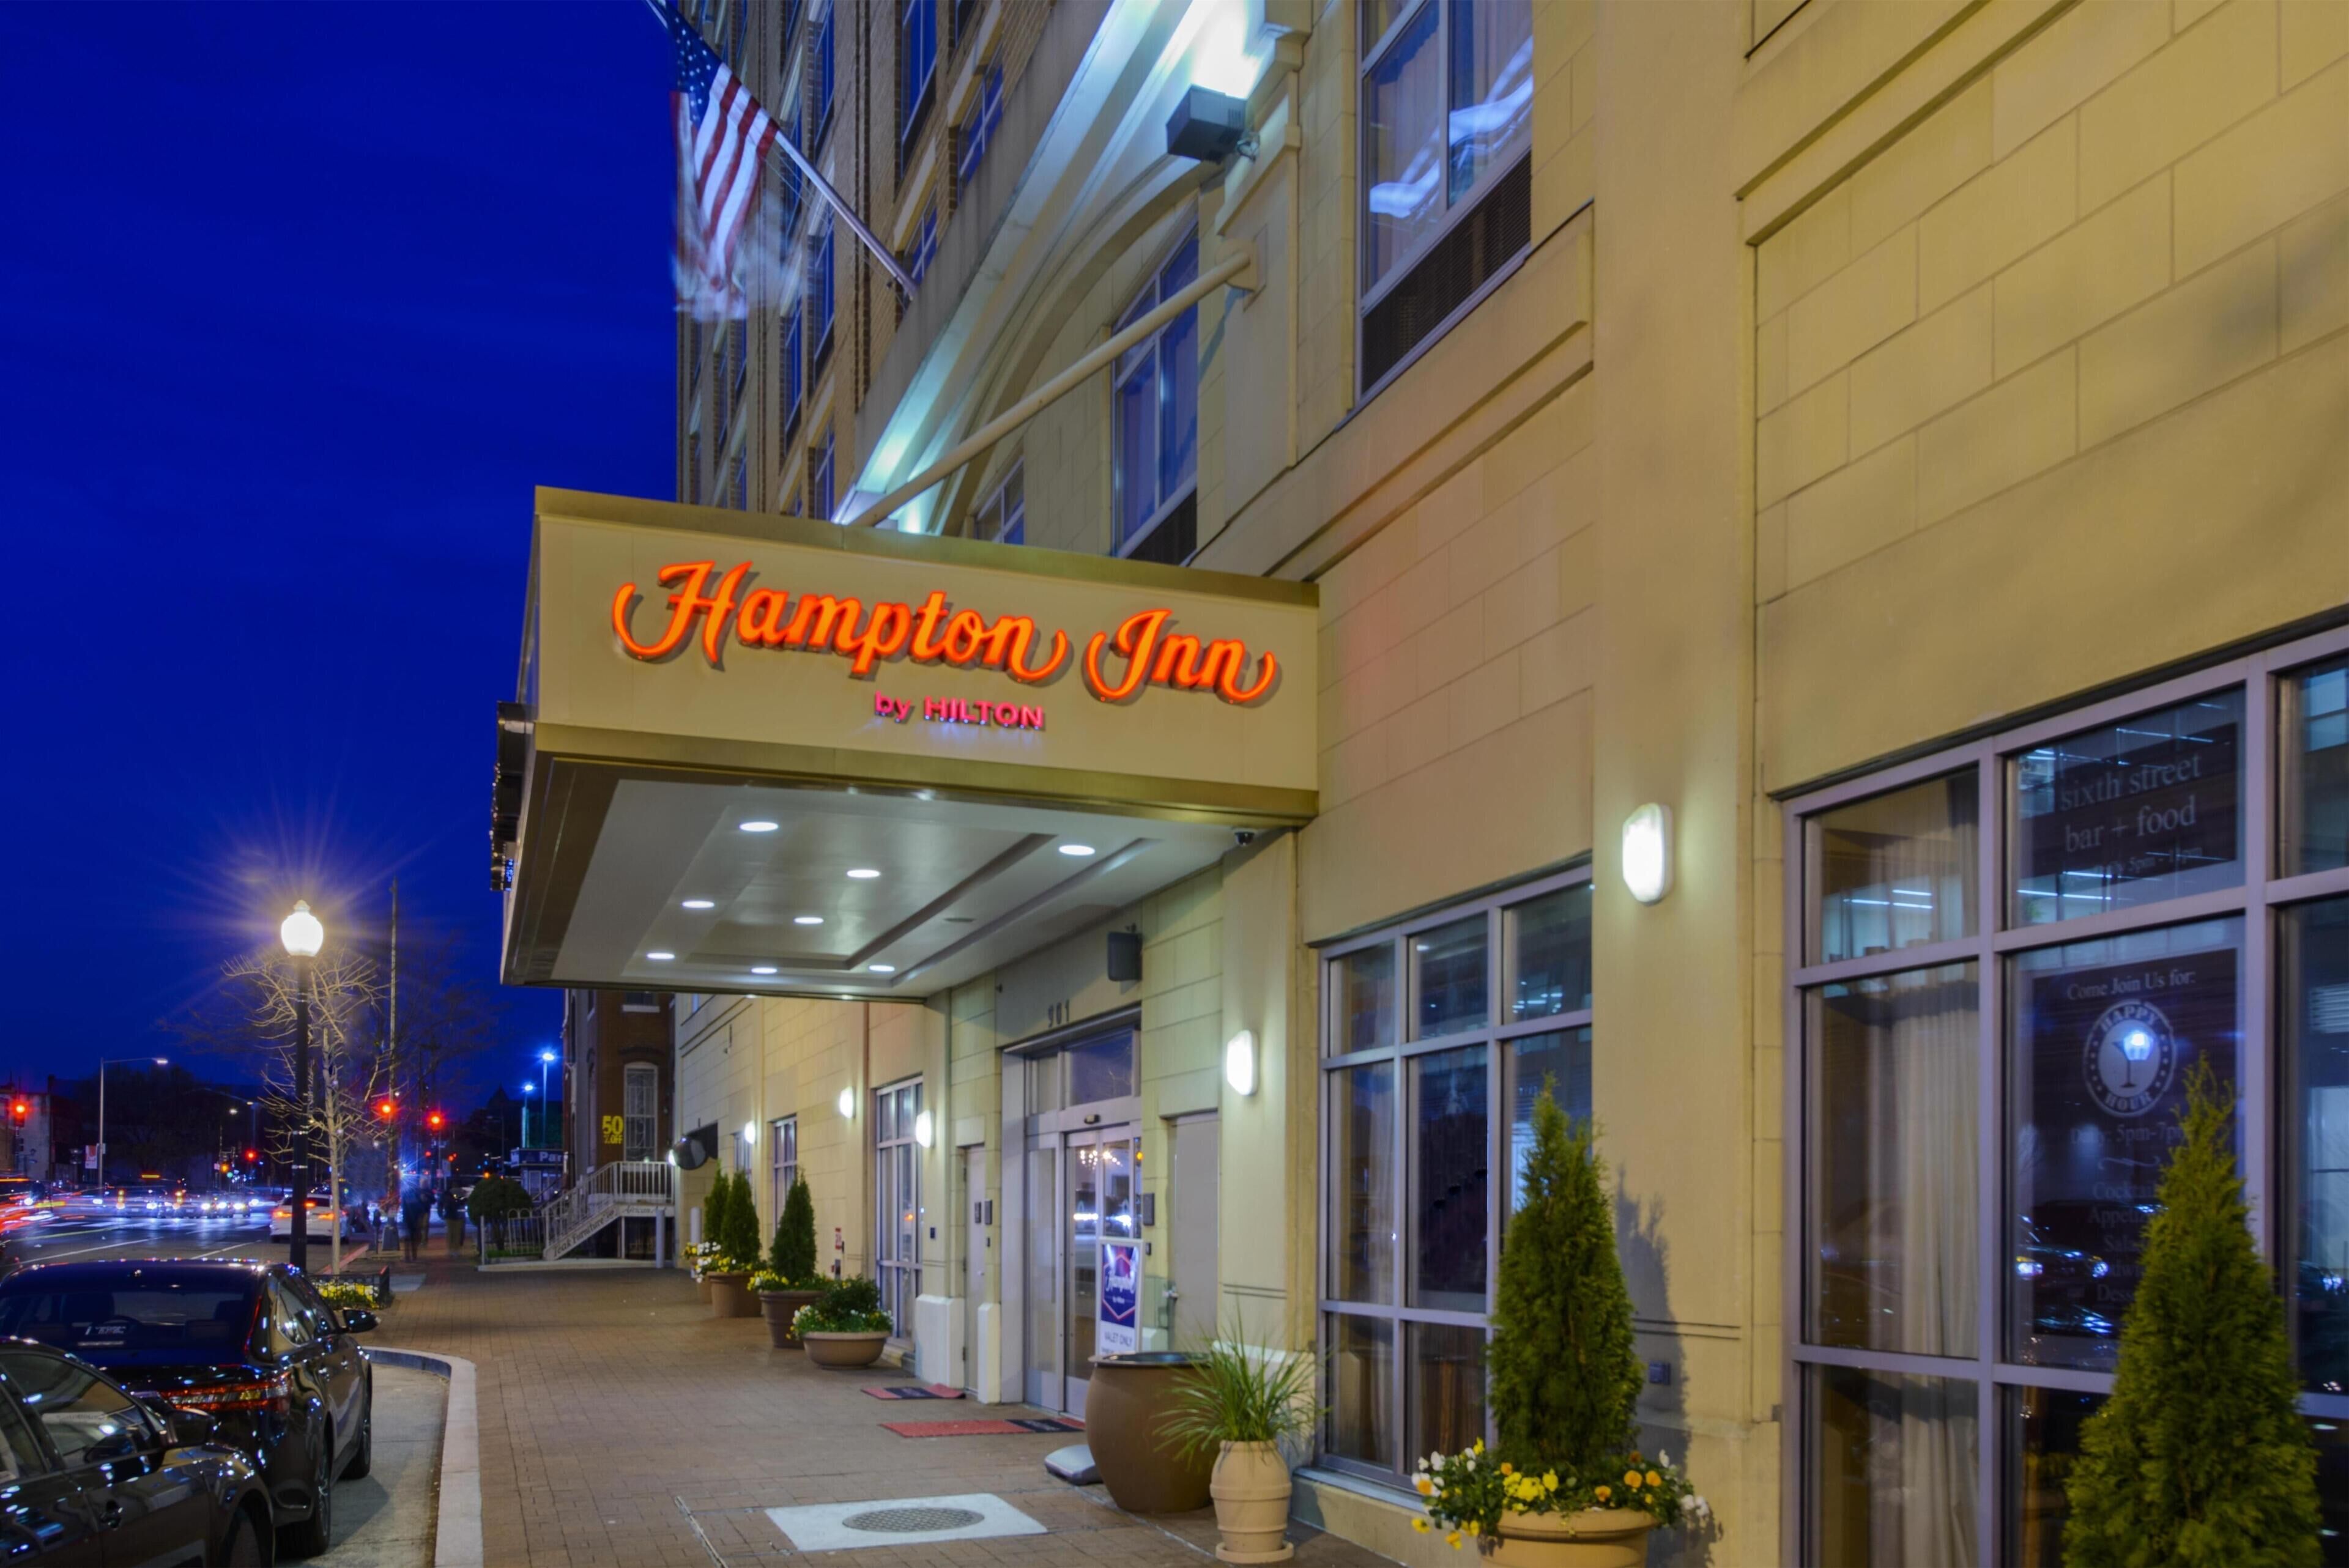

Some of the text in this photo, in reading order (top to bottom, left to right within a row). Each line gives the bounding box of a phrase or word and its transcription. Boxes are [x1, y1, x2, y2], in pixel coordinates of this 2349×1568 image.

[612, 560, 1277, 701] Hampton Inn
[874, 690, 1044, 730] by HILTON
[2060, 753, 2202, 812] sixth street
[2065, 793, 2197, 852] bar + food
[2066, 968, 2195, 1001] Come Join Us for:
[1048, 999, 1070, 1028] 901
[2101, 1005, 2161, 1032] HAPPY
[2104, 1091, 2153, 1112] HOUR
[602, 1115, 623, 1134] 50
[539, 1151, 562, 1163] Par
[2098, 1284, 2134, 1302] Dess
